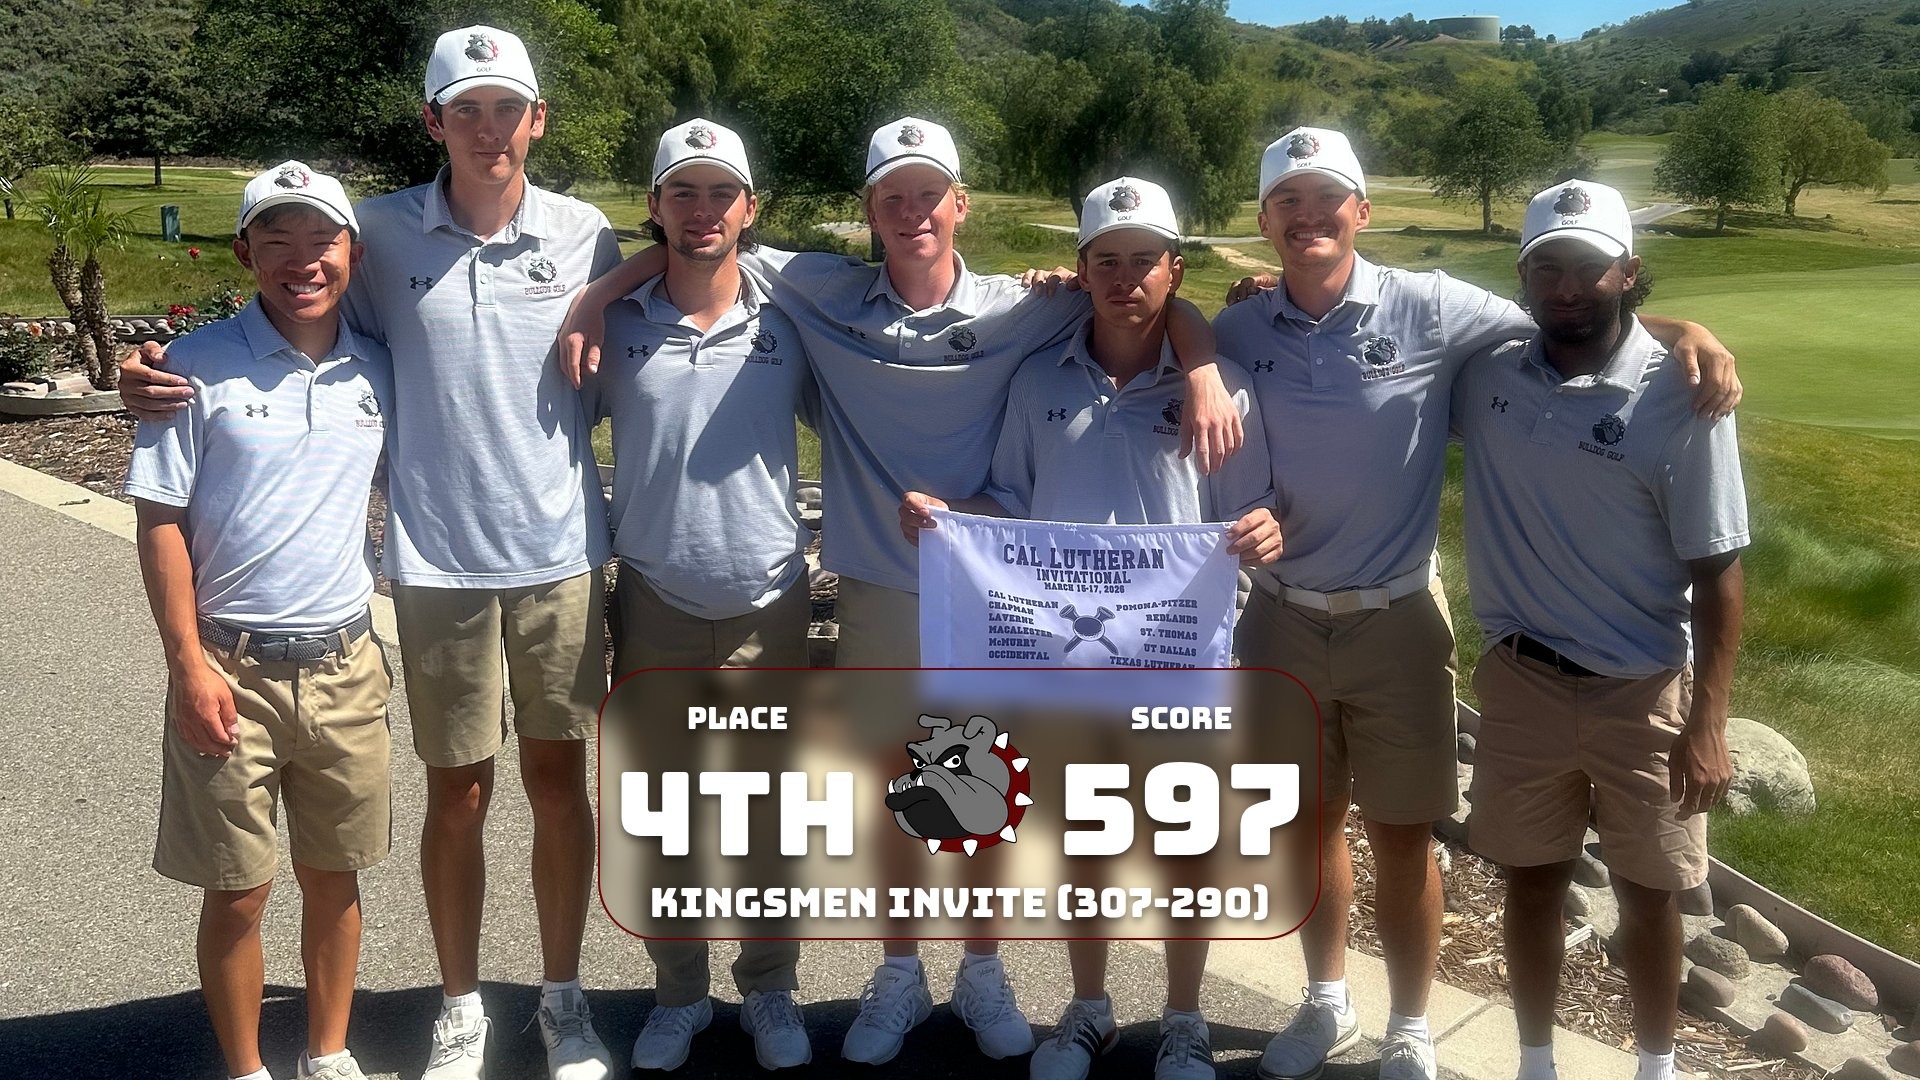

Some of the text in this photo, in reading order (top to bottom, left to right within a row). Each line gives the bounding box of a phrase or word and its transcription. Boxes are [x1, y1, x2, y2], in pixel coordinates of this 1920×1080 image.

[1578, 441, 1625, 462] BULLDOG GOLF
[1003, 543, 1165, 571] CAL LUTHERAN
[1036, 568, 1132, 585] INVITATIONAL
[1044, 582, 1075, 592] MARCH
[1103, 584, 1126, 594] 2026
[988, 589, 1060, 609] CAL LUTHERAN
[1115, 599, 1198, 612] POMONA-PITZER
[988, 600, 1035, 616] CHAPMAN
[988, 612, 1035, 626] LAVERNE
[1145, 613, 1199, 625] REDLANDS
[988, 624, 1054, 639] MACALESTER
[1139, 627, 1198, 641] ST. THOMAS
[988, 637, 1038, 648] McMURRY
[988, 649, 1051, 661] OCCIDENTAL
[1143, 643, 1197, 657] UT DALLAS
[1109, 655, 1142, 668] TEXAS
